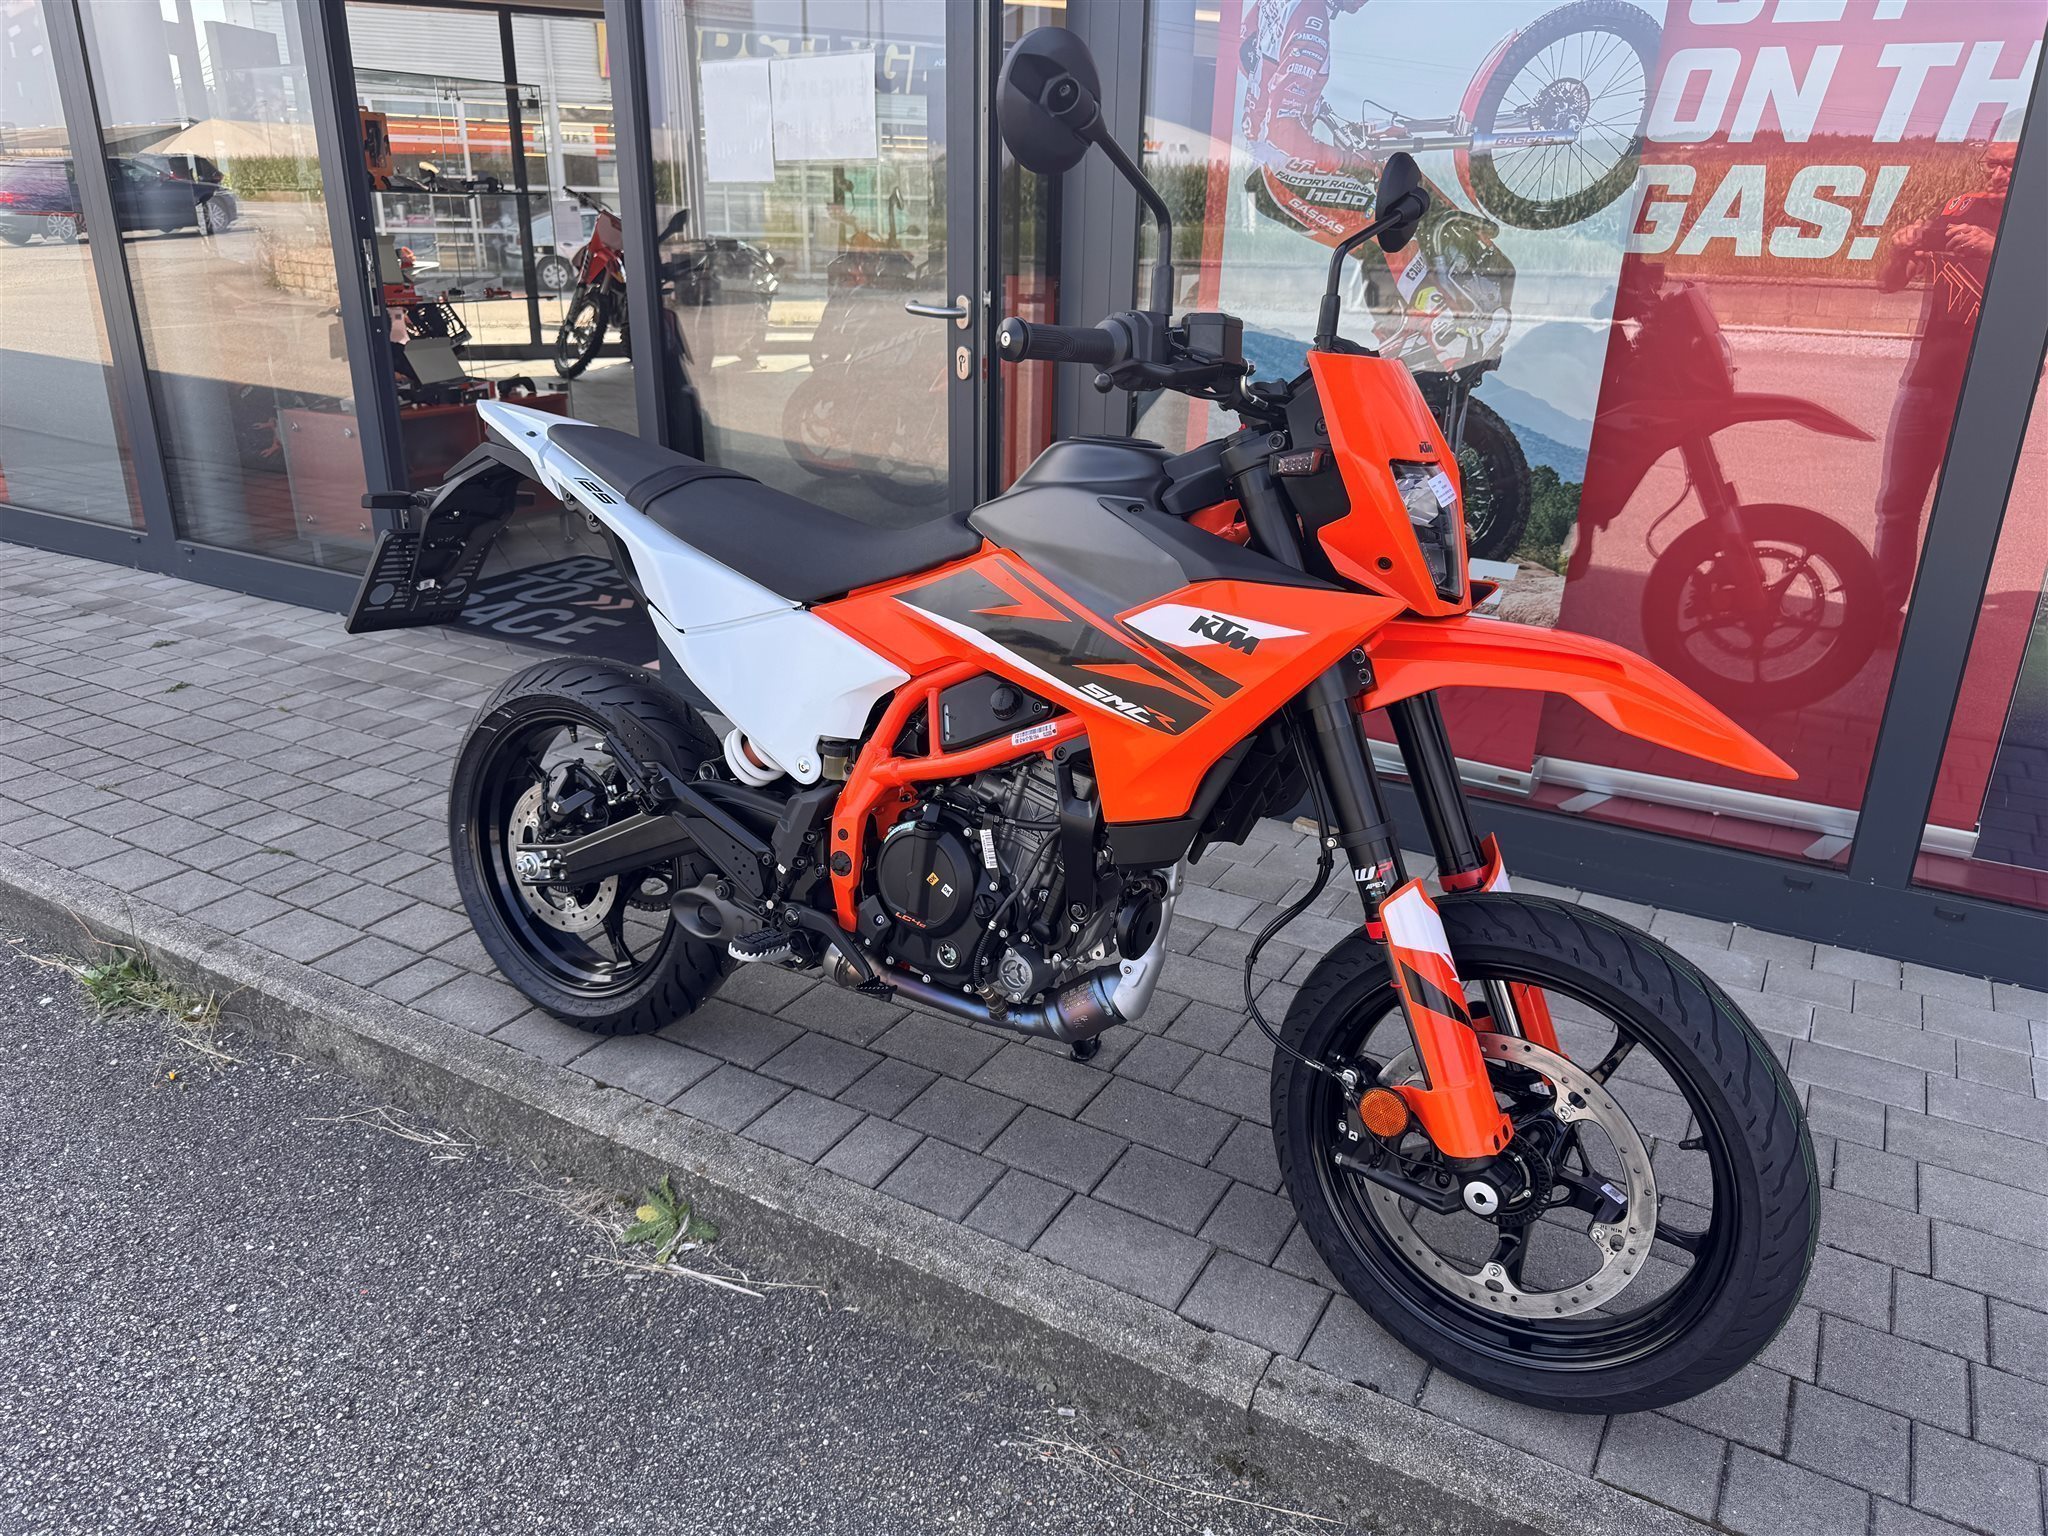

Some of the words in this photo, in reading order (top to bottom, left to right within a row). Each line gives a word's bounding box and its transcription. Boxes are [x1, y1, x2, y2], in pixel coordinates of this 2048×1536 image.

[1646, 45, 1844, 143] ON
[1495, 134, 1556, 146] GASGAS
[1276, 170, 1327, 187] FACTORY
[1329, 179, 1373, 195] RACING
[1288, 198, 1346, 235] GASGAS
[1624, 164, 1911, 261] GAS!
[1418, 441, 1434, 454] KTM
[573, 477, 619, 505] 125
[479, 573, 594, 604] TO
[1187, 613, 1261, 657] KTM
[1355, 860, 1393, 882] WP
[943, 886, 951, 895] OK
[1365, 880, 1388, 891] APEX
